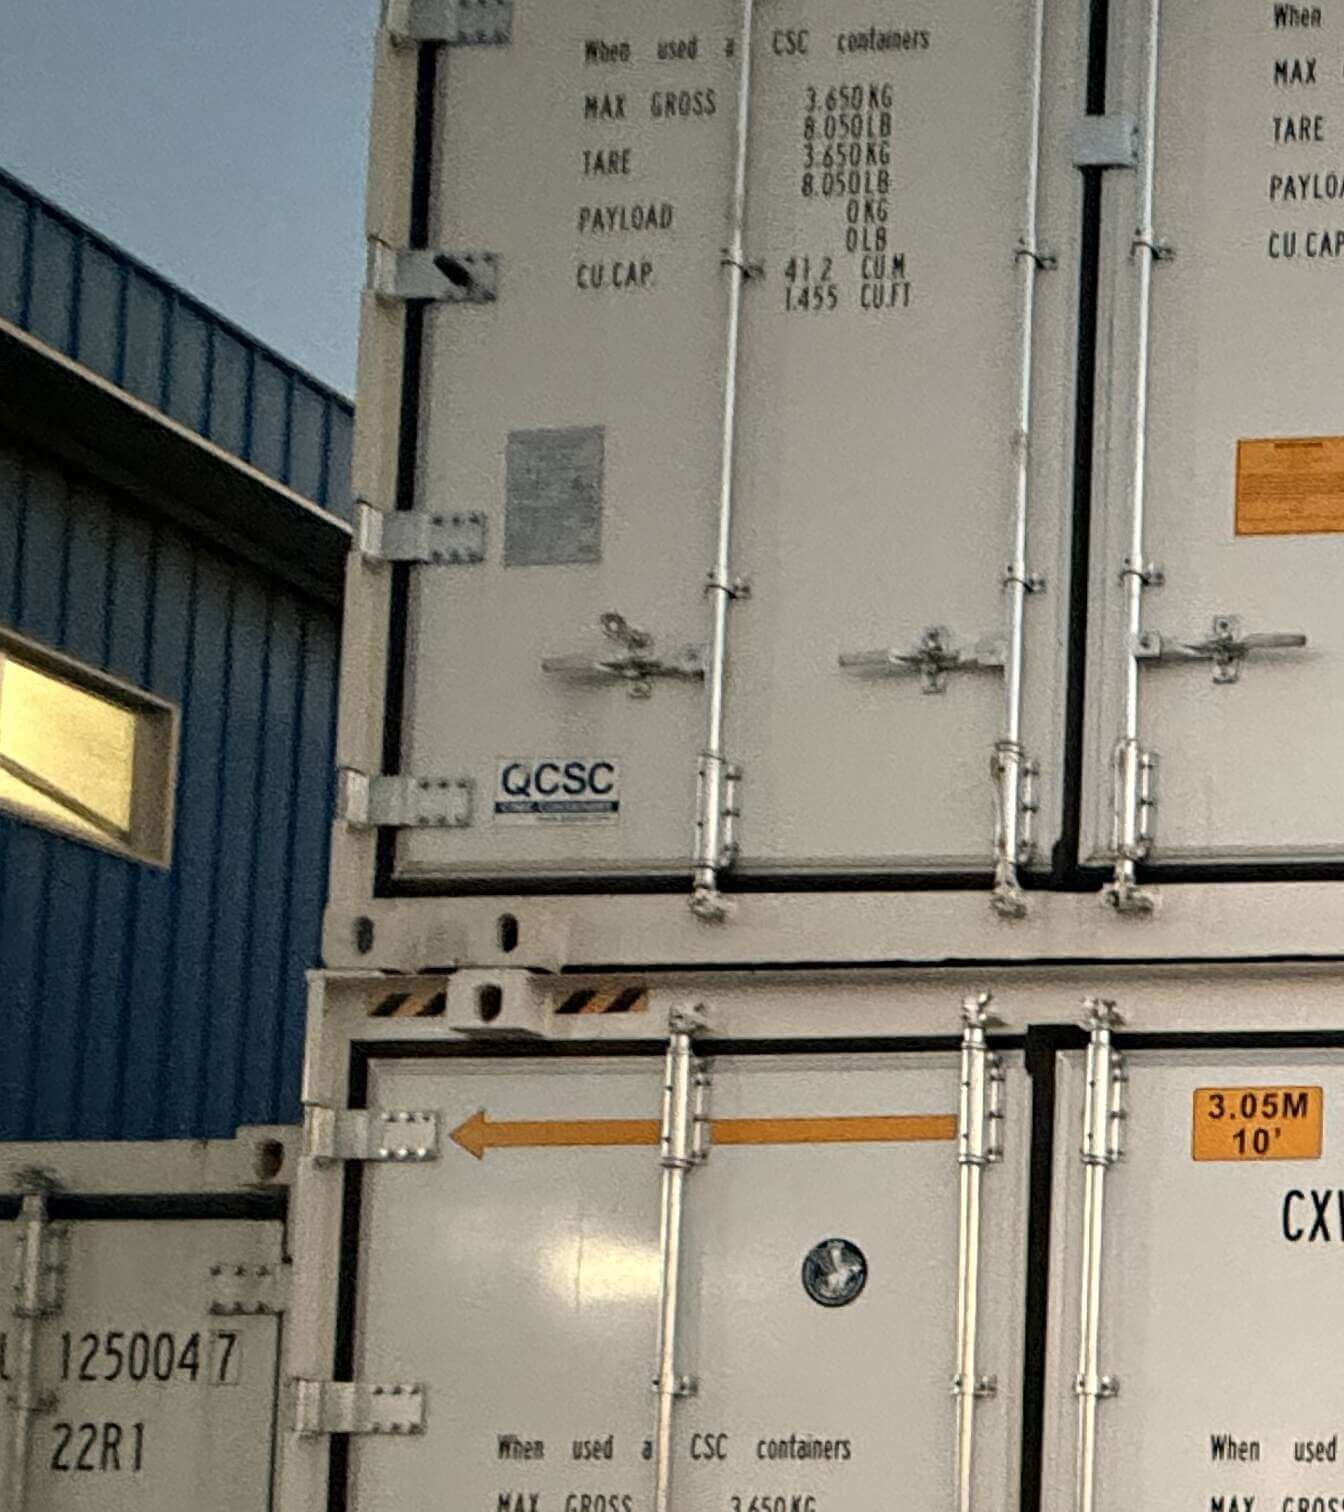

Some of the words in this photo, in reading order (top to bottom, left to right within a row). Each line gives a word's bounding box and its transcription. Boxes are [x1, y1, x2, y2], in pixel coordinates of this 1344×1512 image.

[1274, 4, 1321, 28] When
[772, 30, 808, 56] CSC
[1274, 59, 1316, 84] MAX
[585, 95, 624, 118] MAX
[651, 88, 716, 117] GROSS
[1274, 116, 1323, 142] TARE
[584, 149, 630, 174] TARE
[579, 203, 672, 232] PAYLOAD
[502, 762, 614, 797] QCSC
[1208, 1092, 1308, 1120] 3.05M
[1232, 1127, 1282, 1156] 10'
[51, 1422, 144, 1472] 22R1
[498, 1435, 544, 1460] When
[573, 1435, 613, 1460] used
[690, 1433, 728, 1460] CSC
[757, 1434, 851, 1460] containers
[1211, 1435, 1259, 1461] When
[1295, 1436, 1337, 1463] used
